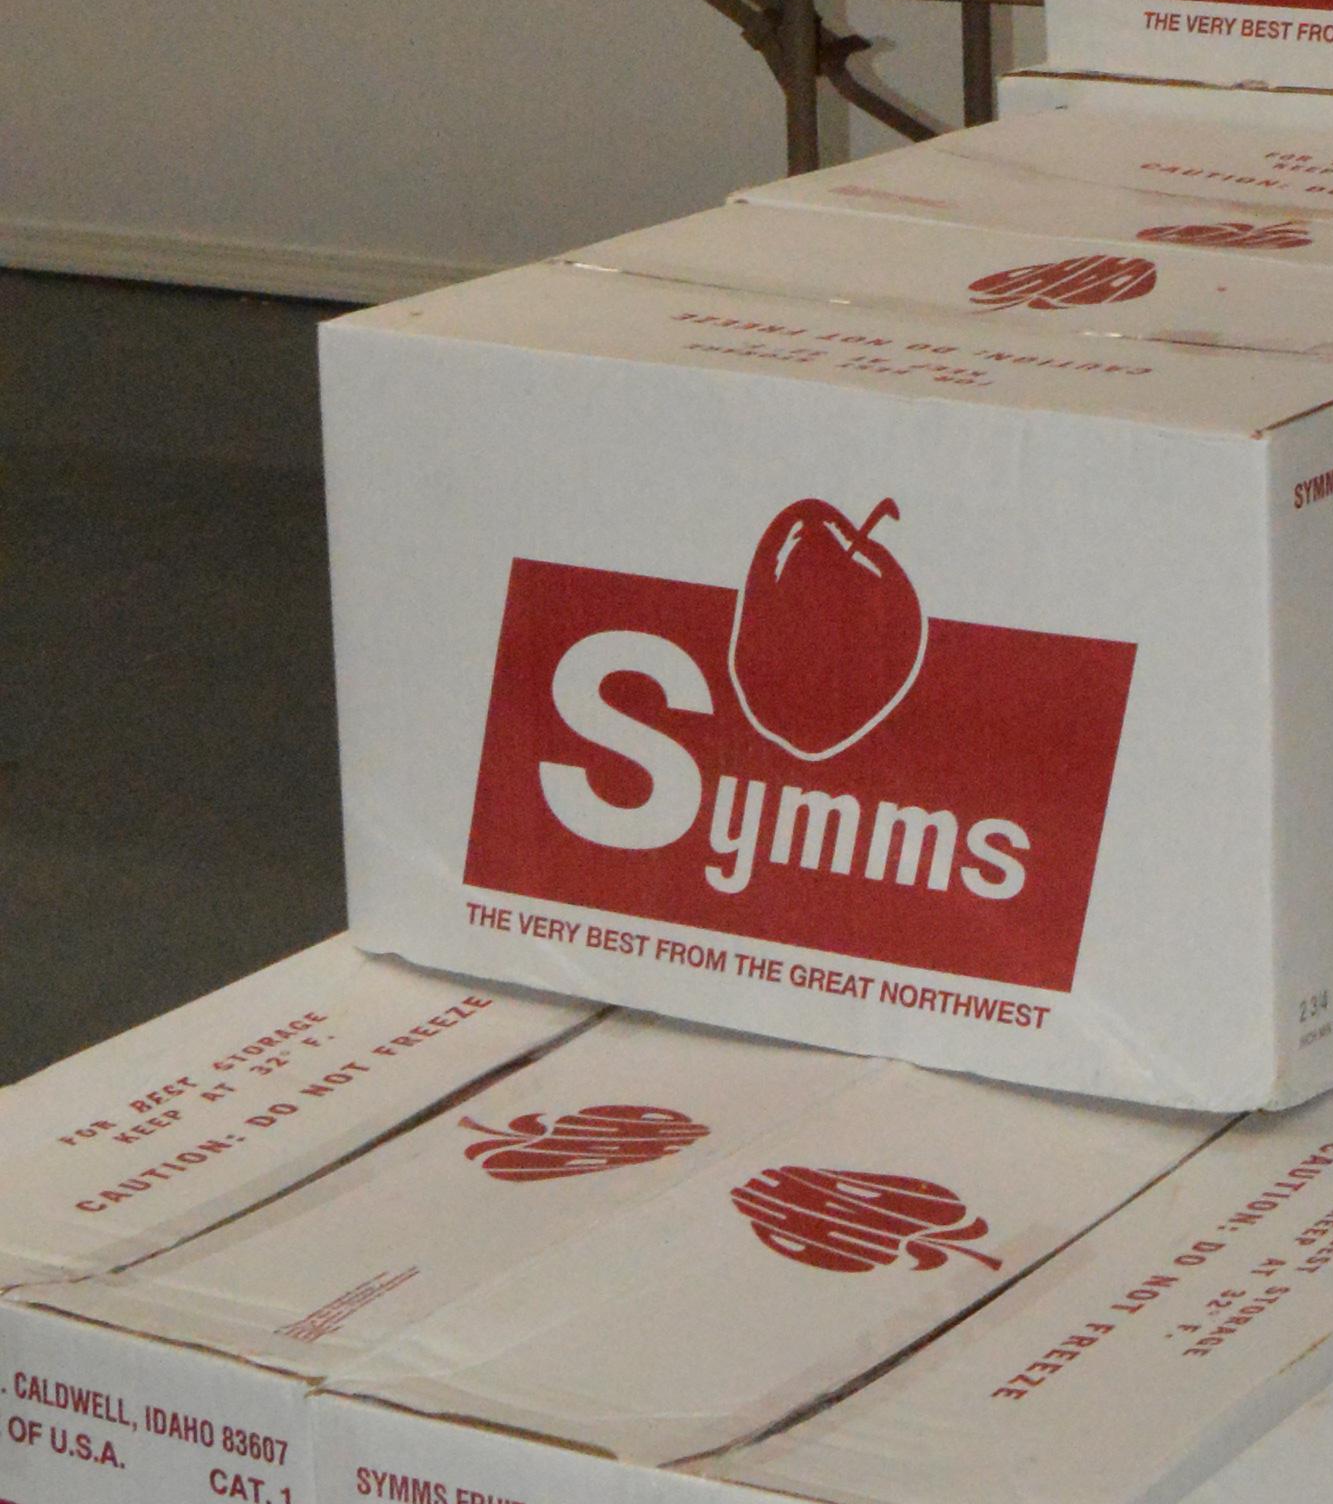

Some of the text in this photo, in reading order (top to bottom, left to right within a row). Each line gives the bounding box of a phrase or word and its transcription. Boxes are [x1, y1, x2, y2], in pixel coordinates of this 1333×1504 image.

[1143, 10, 1181, 32] THE
[1186, 14, 1238, 35] VERY
[1239, 18, 1293, 40] BEST
[539, 630, 1032, 900] Symms
[466, 901, 1052, 1029] THE VERY BEST FROM THE GREAT NORTHWEST
[60, 1011, 326, 1147] FOR BEST STORAGE
[75, 996, 494, 1215] CAUTION: DO NOT FREEZE
[14, 1370, 288, 1466] CALDWELL, IDAHO 83607
